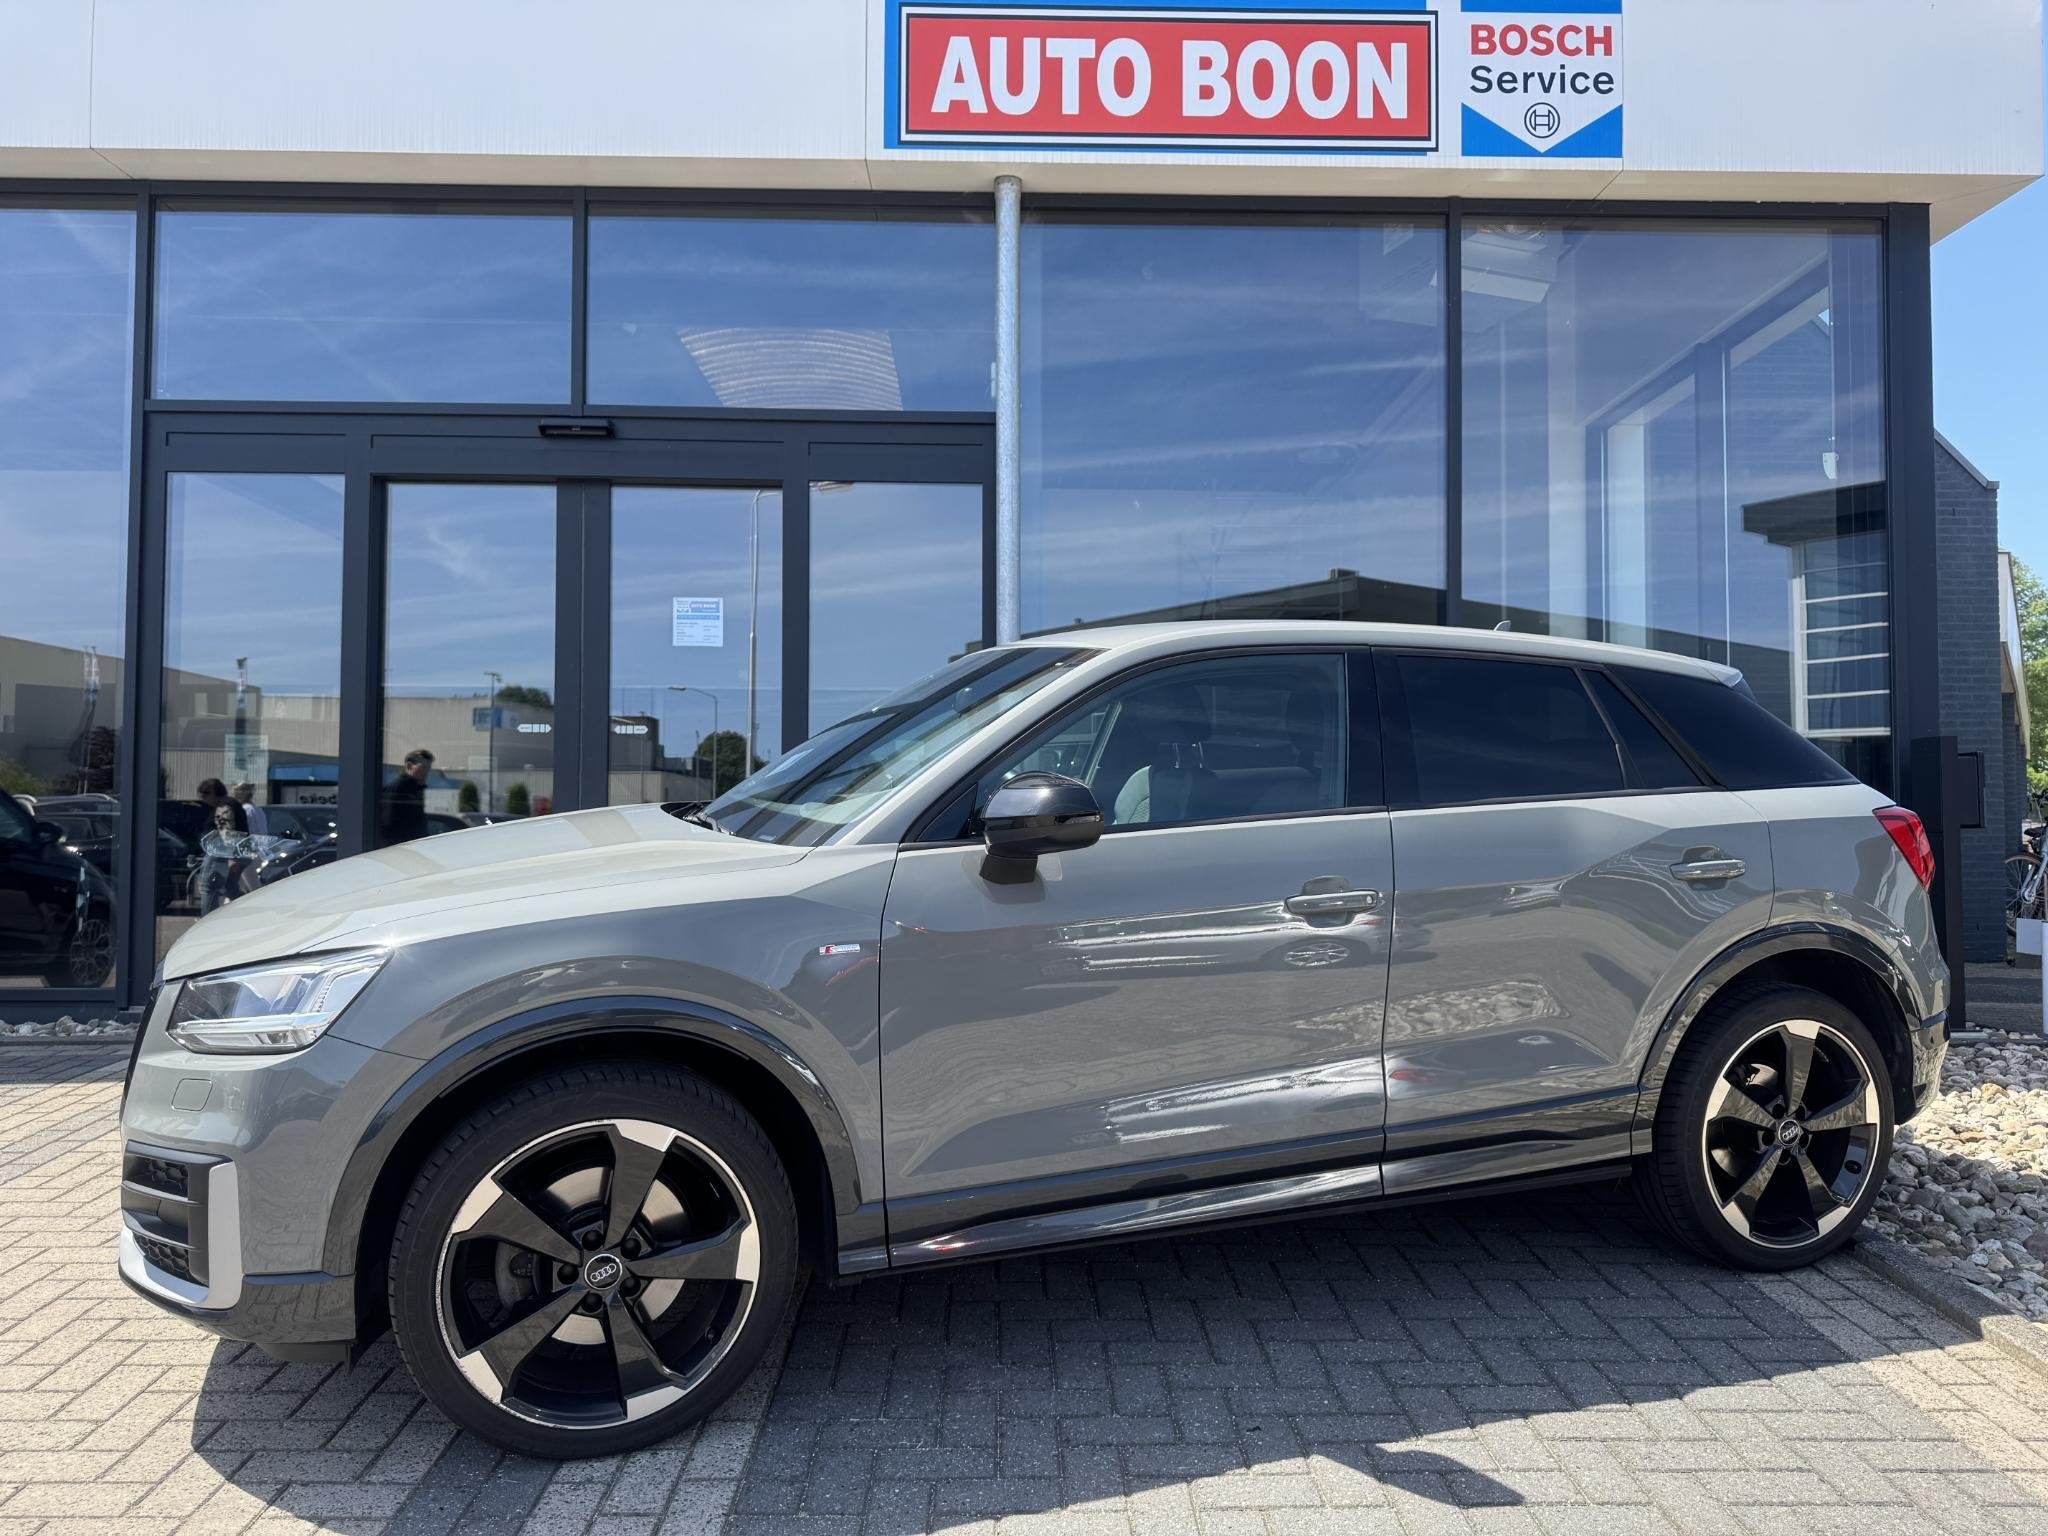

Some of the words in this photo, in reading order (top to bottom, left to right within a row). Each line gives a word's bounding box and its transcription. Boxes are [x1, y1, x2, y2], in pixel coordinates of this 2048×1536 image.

[1470, 24, 1613, 57] BOSCH
[931, 36, 1152, 117] AUTO
[1182, 40, 1408, 119] BOON
[1469, 64, 1615, 95] Service
